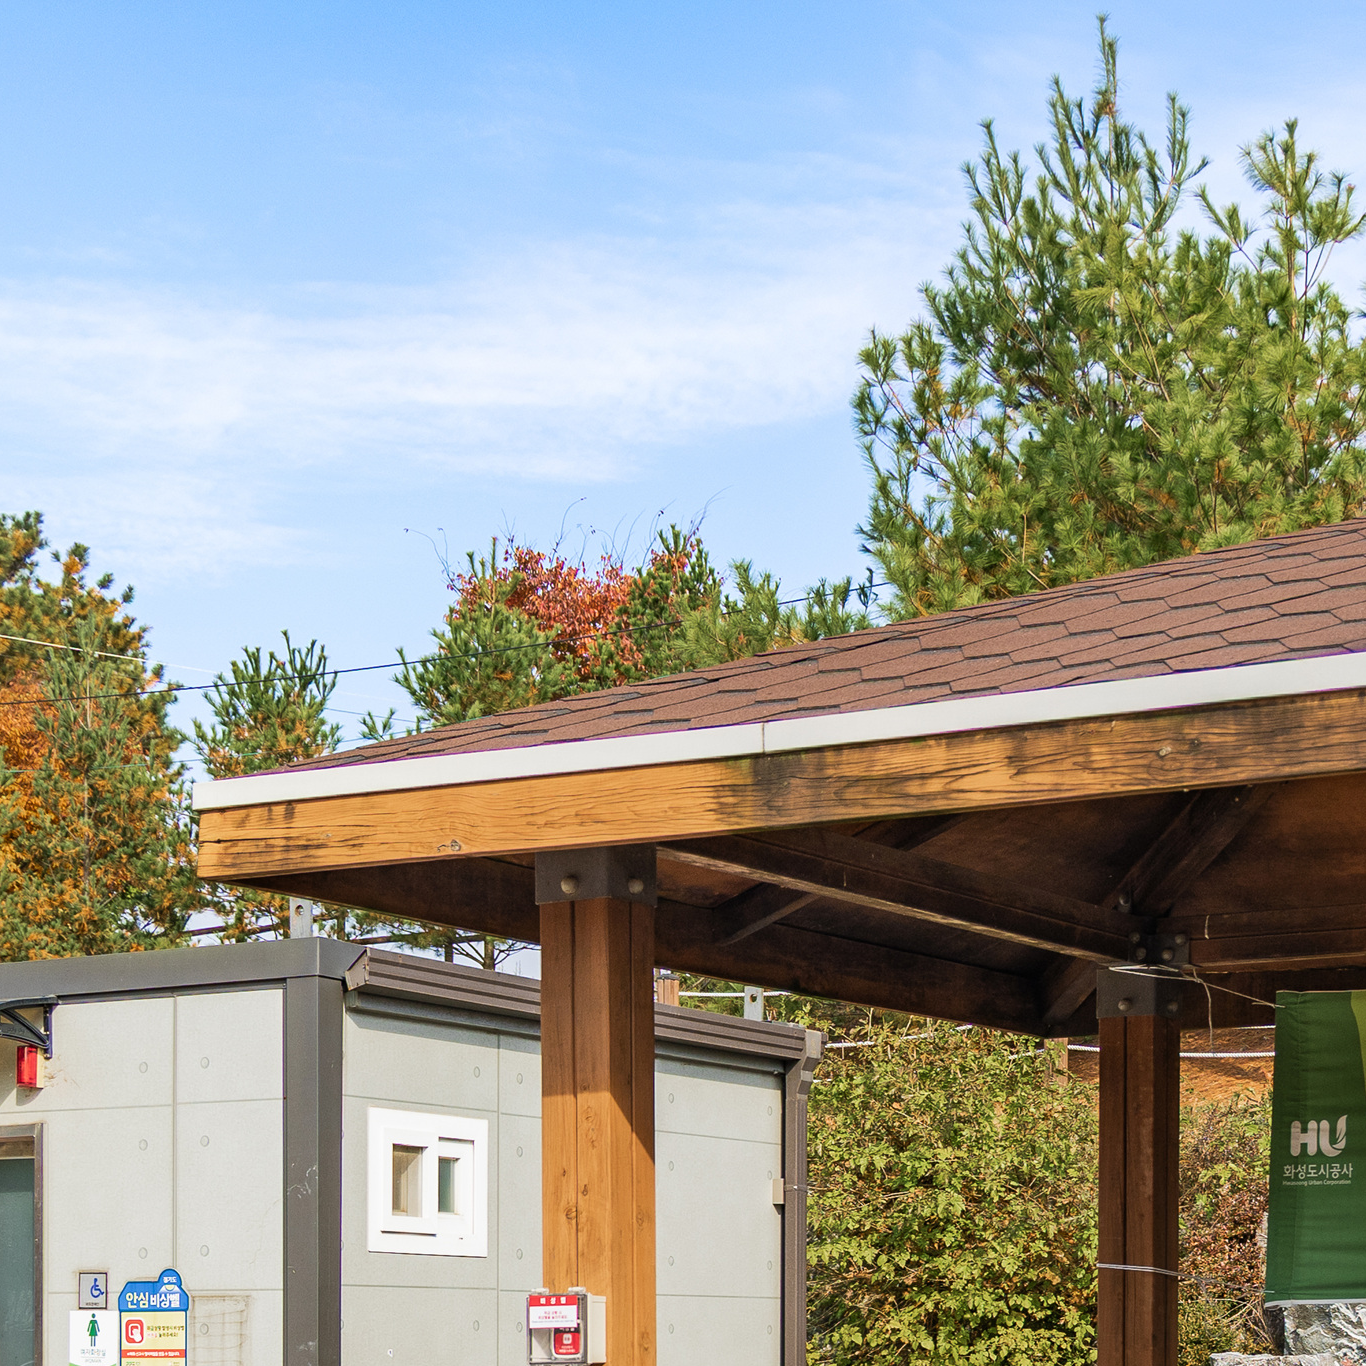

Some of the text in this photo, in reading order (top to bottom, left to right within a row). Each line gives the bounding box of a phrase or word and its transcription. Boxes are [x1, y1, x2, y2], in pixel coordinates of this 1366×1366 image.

[1290, 1115, 1348, 1157] HU
[1282, 1163, 1354, 1180] 화성도시공사
[125, 1292, 181, 1309] 안심 비상벨
